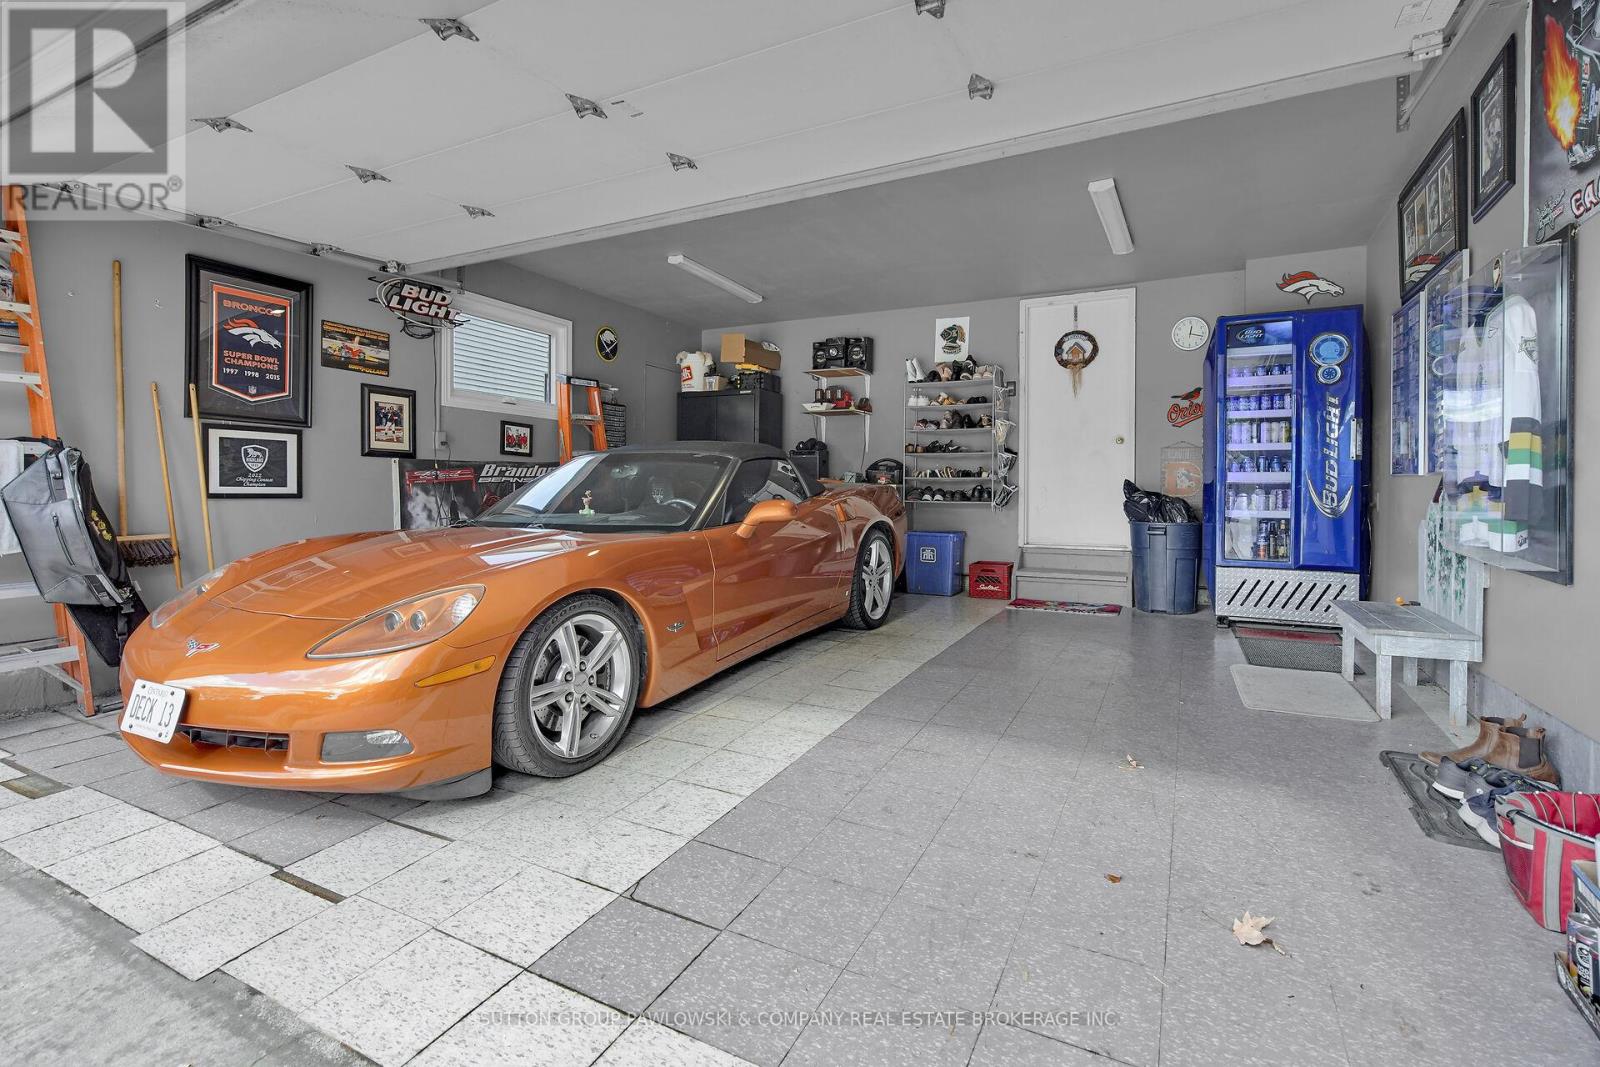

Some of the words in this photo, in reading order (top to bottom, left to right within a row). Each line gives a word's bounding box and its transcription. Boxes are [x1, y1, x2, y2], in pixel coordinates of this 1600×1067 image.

[400, 284, 453, 305] BUD
[223, 300, 282, 317] BRONCOS
[389, 295, 462, 320] LIGHT
[223, 350, 253, 361] SUPER
[254, 355, 280, 365] BOWL
[223, 357, 279, 371] CHAMPIONS
[222, 367, 239, 375] 1997
[243, 370, 260, 378] 1998
[265, 373, 281, 381] 2015
[1323, 392, 1341, 459] LIGHT
[1323, 459, 1339, 507] BUD
[130, 694, 158, 723] DECK
[158, 702, 175, 728] 13
